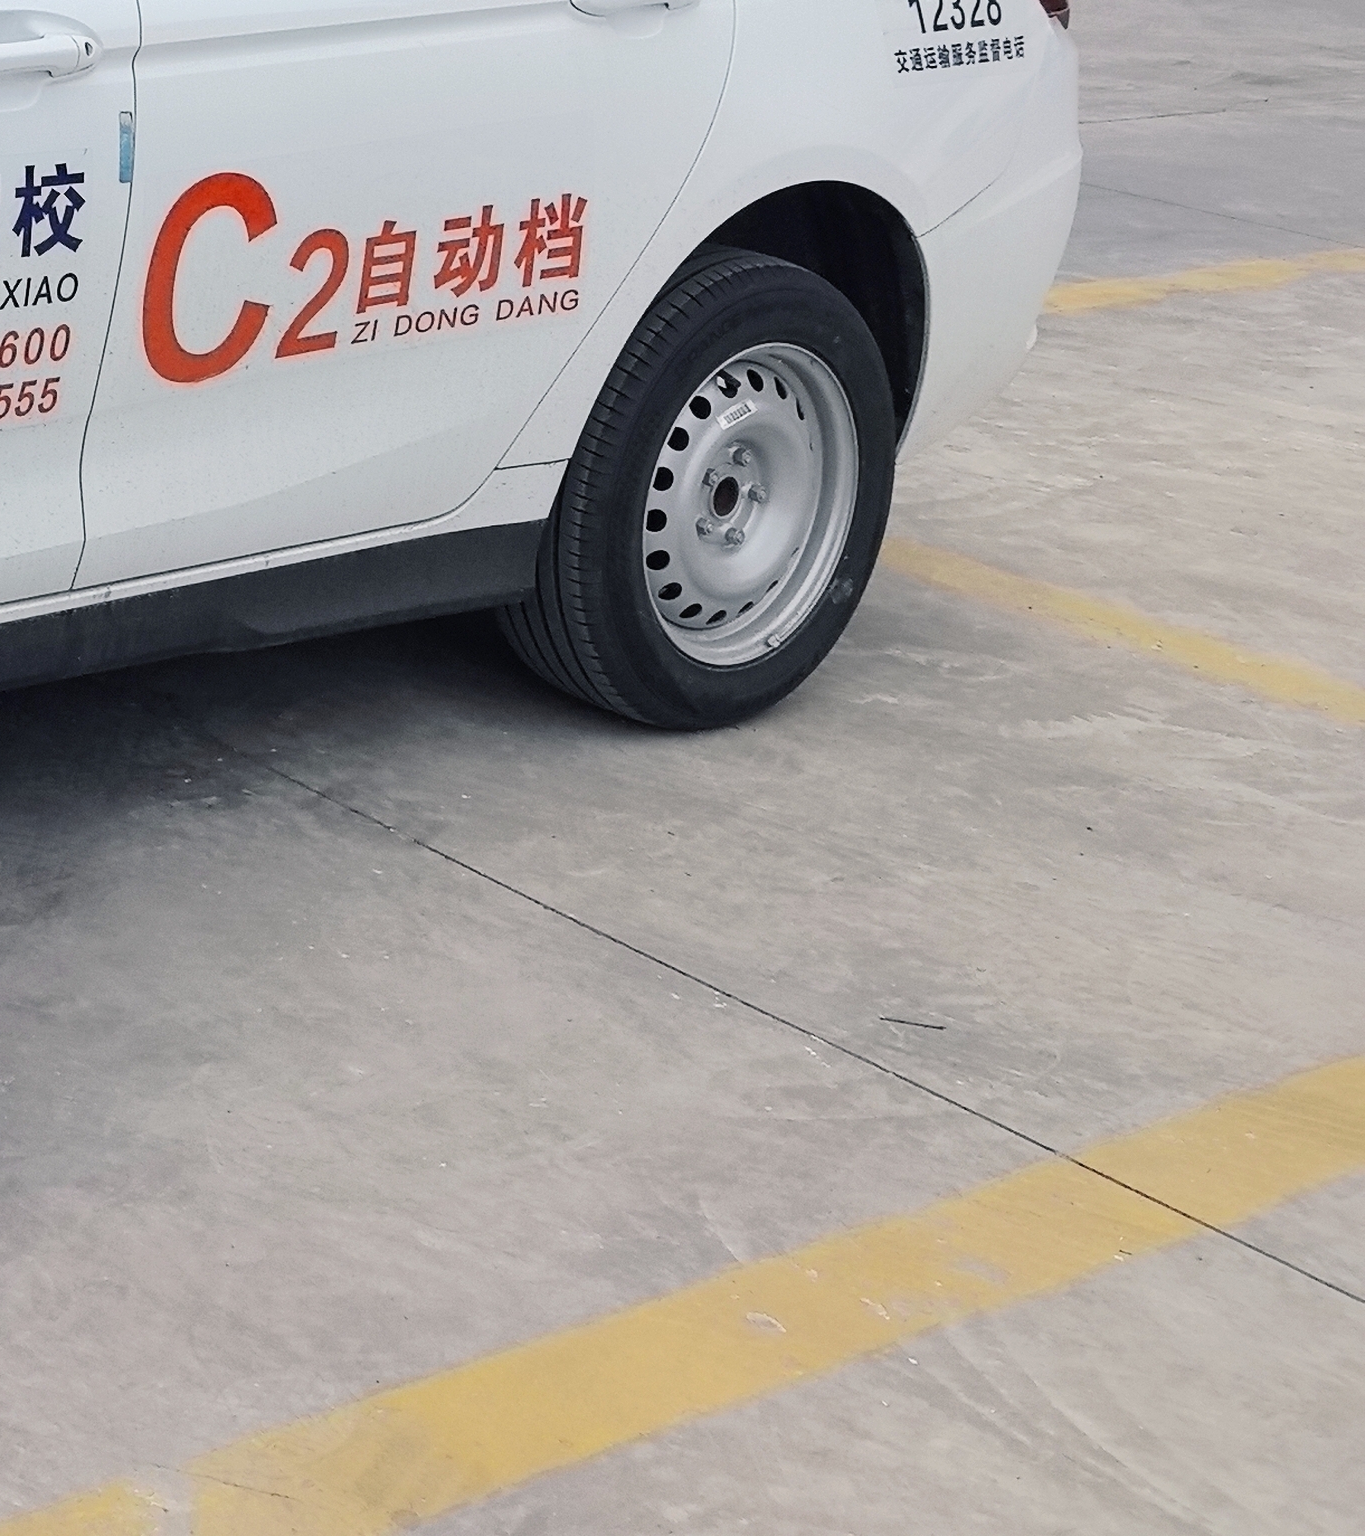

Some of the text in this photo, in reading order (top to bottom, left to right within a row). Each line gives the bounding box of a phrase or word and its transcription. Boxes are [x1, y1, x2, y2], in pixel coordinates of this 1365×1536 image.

[893, 35, 1026, 74] 交通运输服务监督电话
[350, 289, 580, 345] ZI DONG DANG
